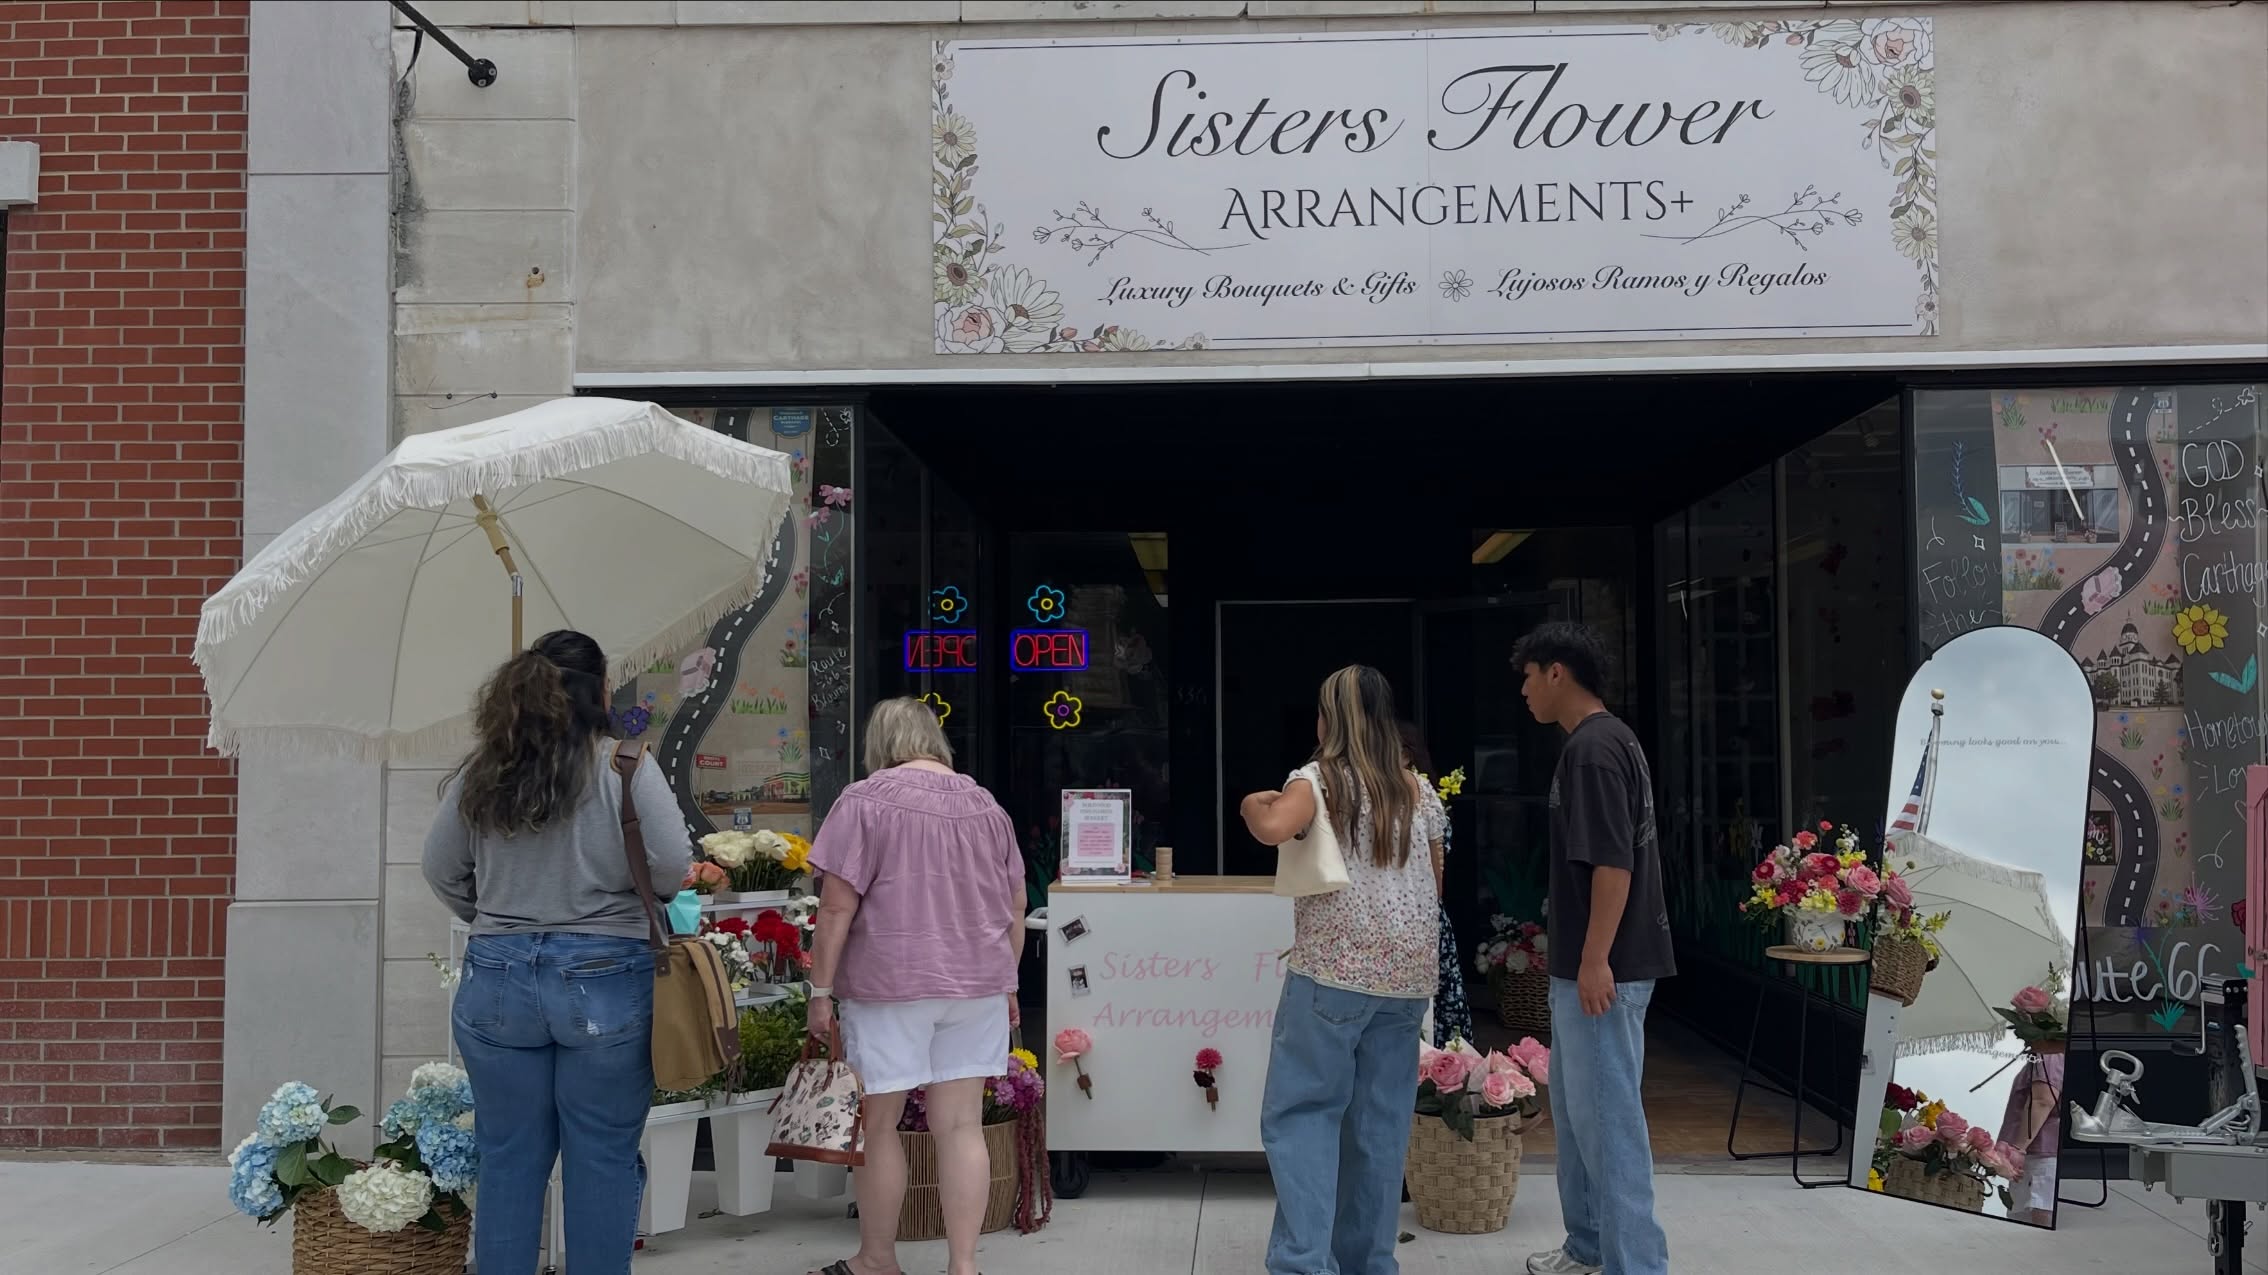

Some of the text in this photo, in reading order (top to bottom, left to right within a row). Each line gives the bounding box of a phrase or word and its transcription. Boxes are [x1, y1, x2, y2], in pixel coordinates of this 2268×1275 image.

[1097, 63, 1775, 159] Sisters Flower
[1219, 180, 1694, 240] ARRANGEMENTS+
[1098, 270, 1418, 308] Luxury Bouquets & Gifts
[1488, 262, 1829, 300] Lujosos Ramos y Regalos
[2182, 439, 2244, 487] GOD
[2180, 493, 2257, 542] Bless
[1939, 608, 1986, 635] the
[810, 647, 847, 676] Route
[1014, 633, 1085, 667] OPEN
[2184, 709, 2268, 750] Hometow
[1100, 950, 1286, 982] Sisters Fl
[2074, 956, 2164, 1002] ute
[1092, 1001, 1276, 1038] Arrangem
